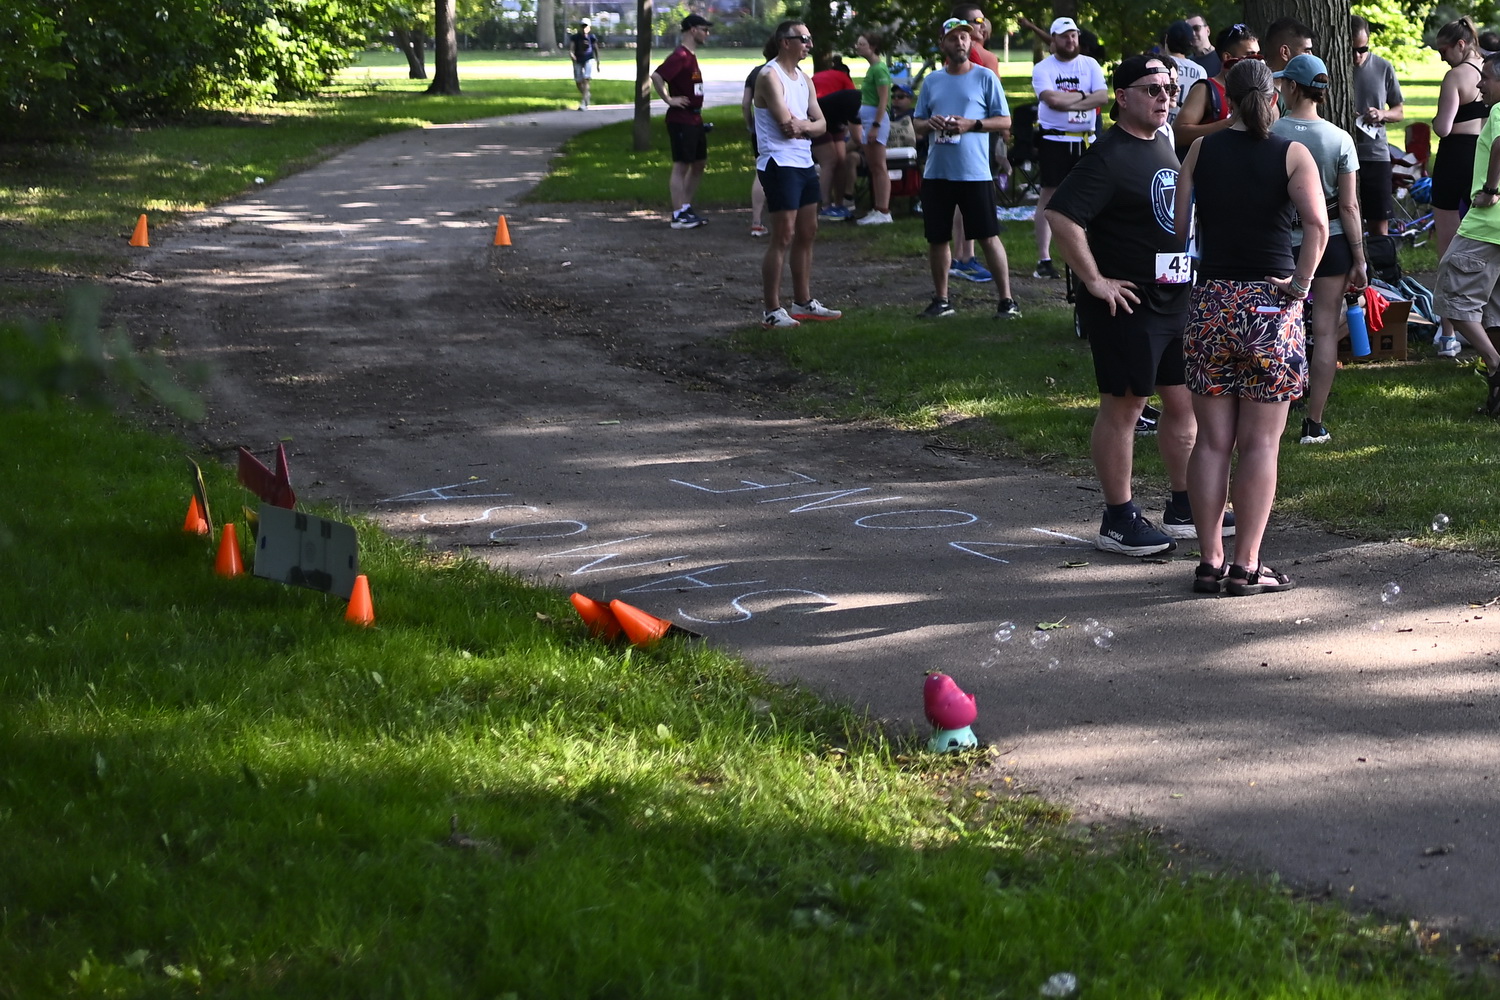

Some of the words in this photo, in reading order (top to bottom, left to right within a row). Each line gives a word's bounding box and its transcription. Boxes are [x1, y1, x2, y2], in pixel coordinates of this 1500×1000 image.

[1178, 65, 1201, 80] STON
[1075, 110, 1087, 119] 26
[1168, 255, 1189, 274] 43
[1107, 529, 1124, 541] HOKA
[378, 478, 839, 624] SAMOSA
